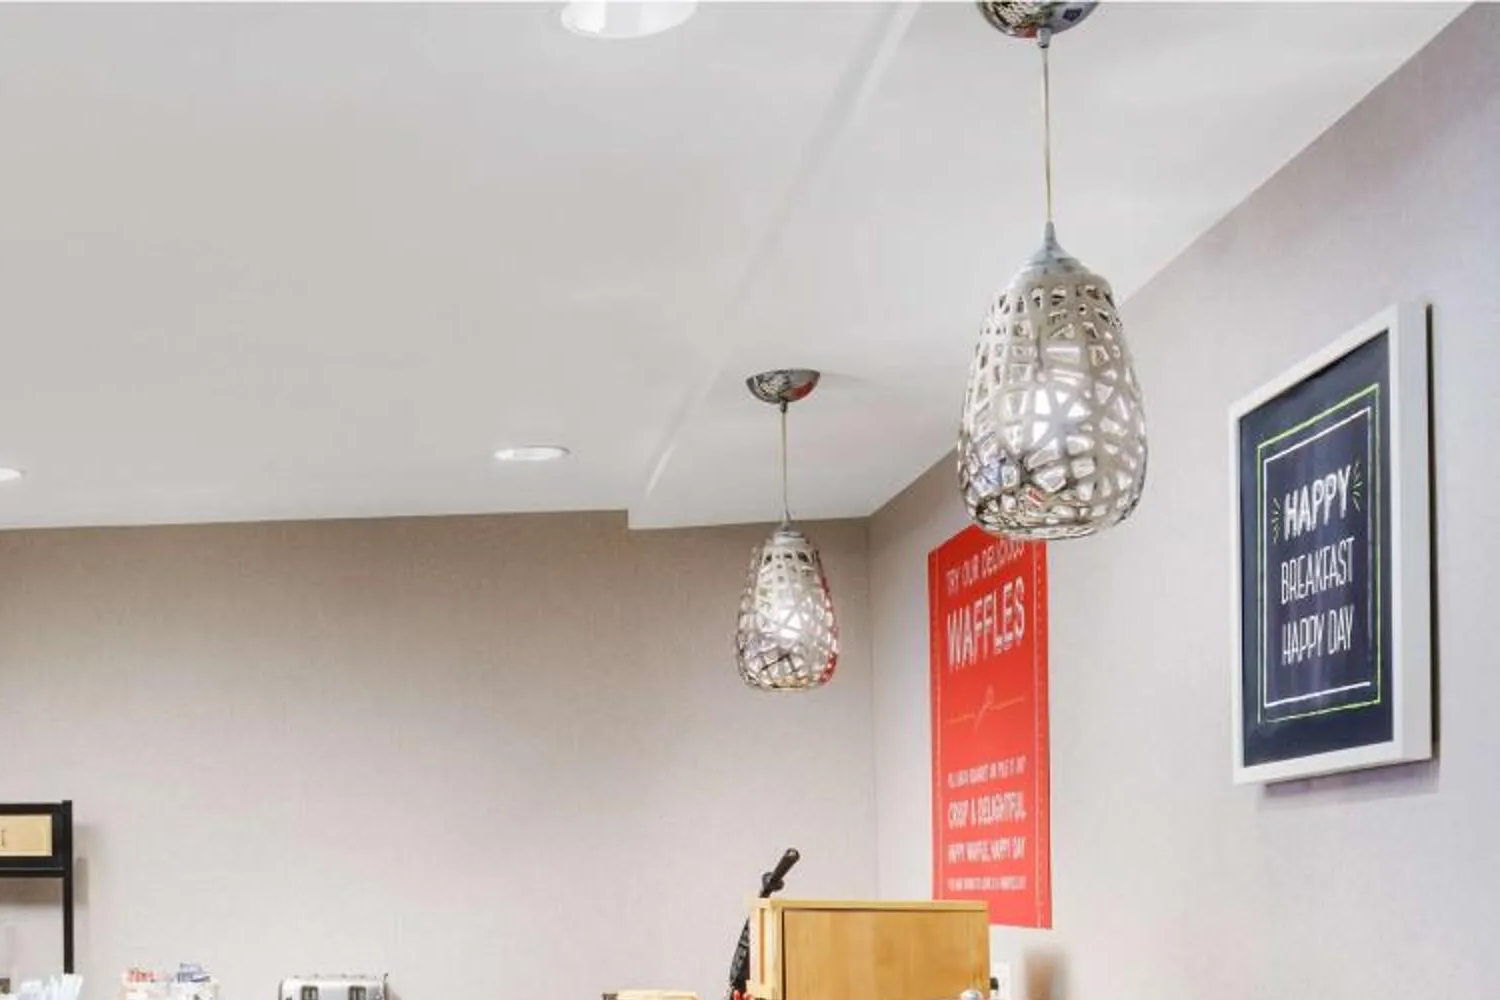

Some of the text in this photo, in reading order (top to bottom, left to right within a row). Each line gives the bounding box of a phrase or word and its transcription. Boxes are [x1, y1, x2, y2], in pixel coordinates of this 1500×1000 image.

[1284, 464, 1351, 541] HAPPY
[1281, 536, 1355, 605] BREAKFAST
[946, 575, 1025, 670] WAFFLES
[1282, 604, 1355, 666] HAPPY DAY
